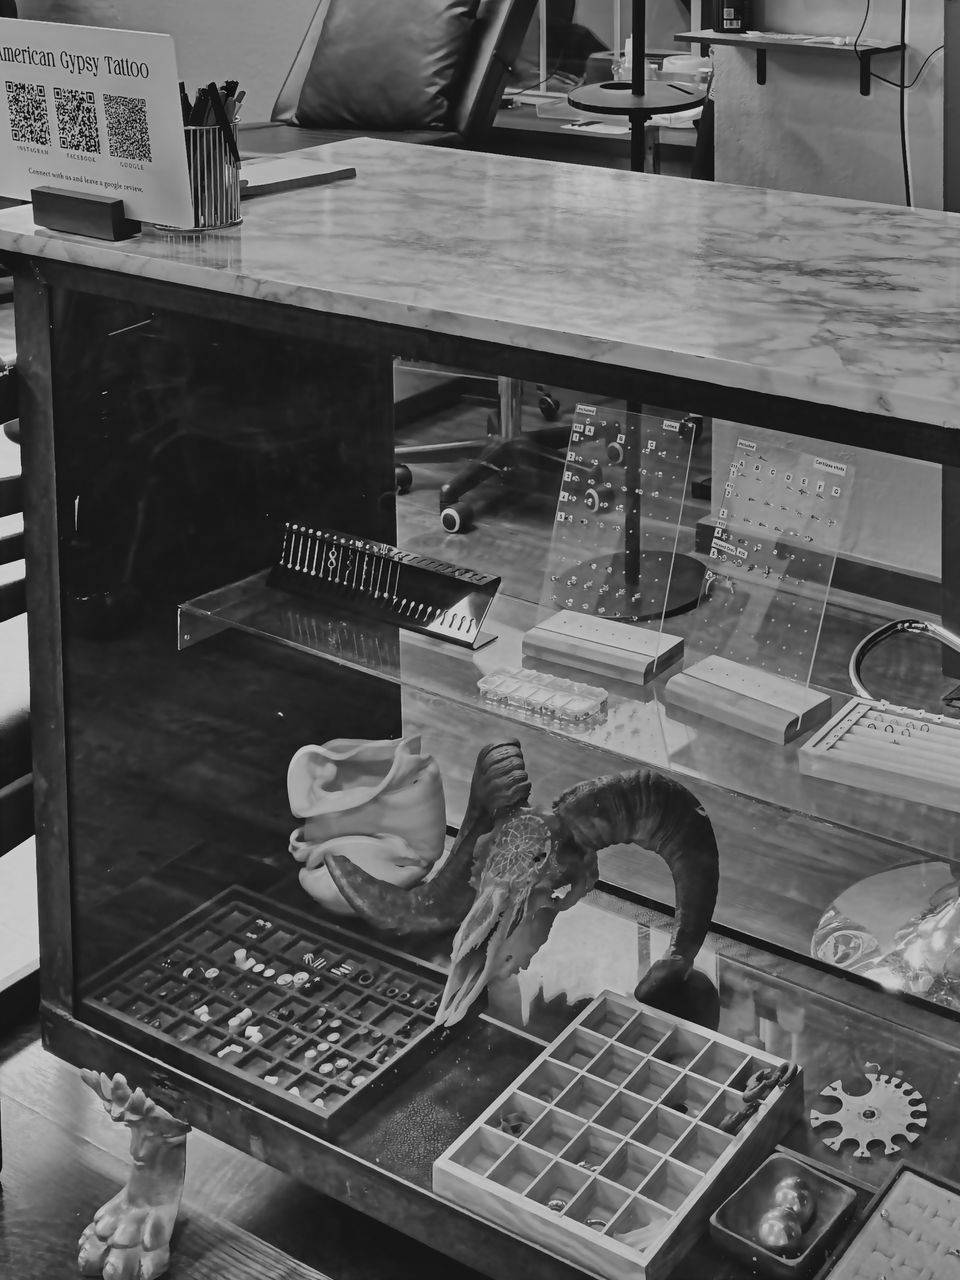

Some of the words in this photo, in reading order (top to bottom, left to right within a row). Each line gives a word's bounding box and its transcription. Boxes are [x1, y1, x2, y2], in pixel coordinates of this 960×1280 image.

[60, 50, 99, 77] Gypsy
[104, 56, 149, 78] Tattoo
[17, 145, 49, 155] INSTAGRAM
[66, 153, 96, 162] FACEBOOK
[120, 162, 145, 170] GOOGLE
[28, 168, 51, 178] Connect
[52, 171, 64, 180] with
[73, 175, 83, 183] and
[84, 176, 98, 186] leave
[104, 180, 122, 191] google
